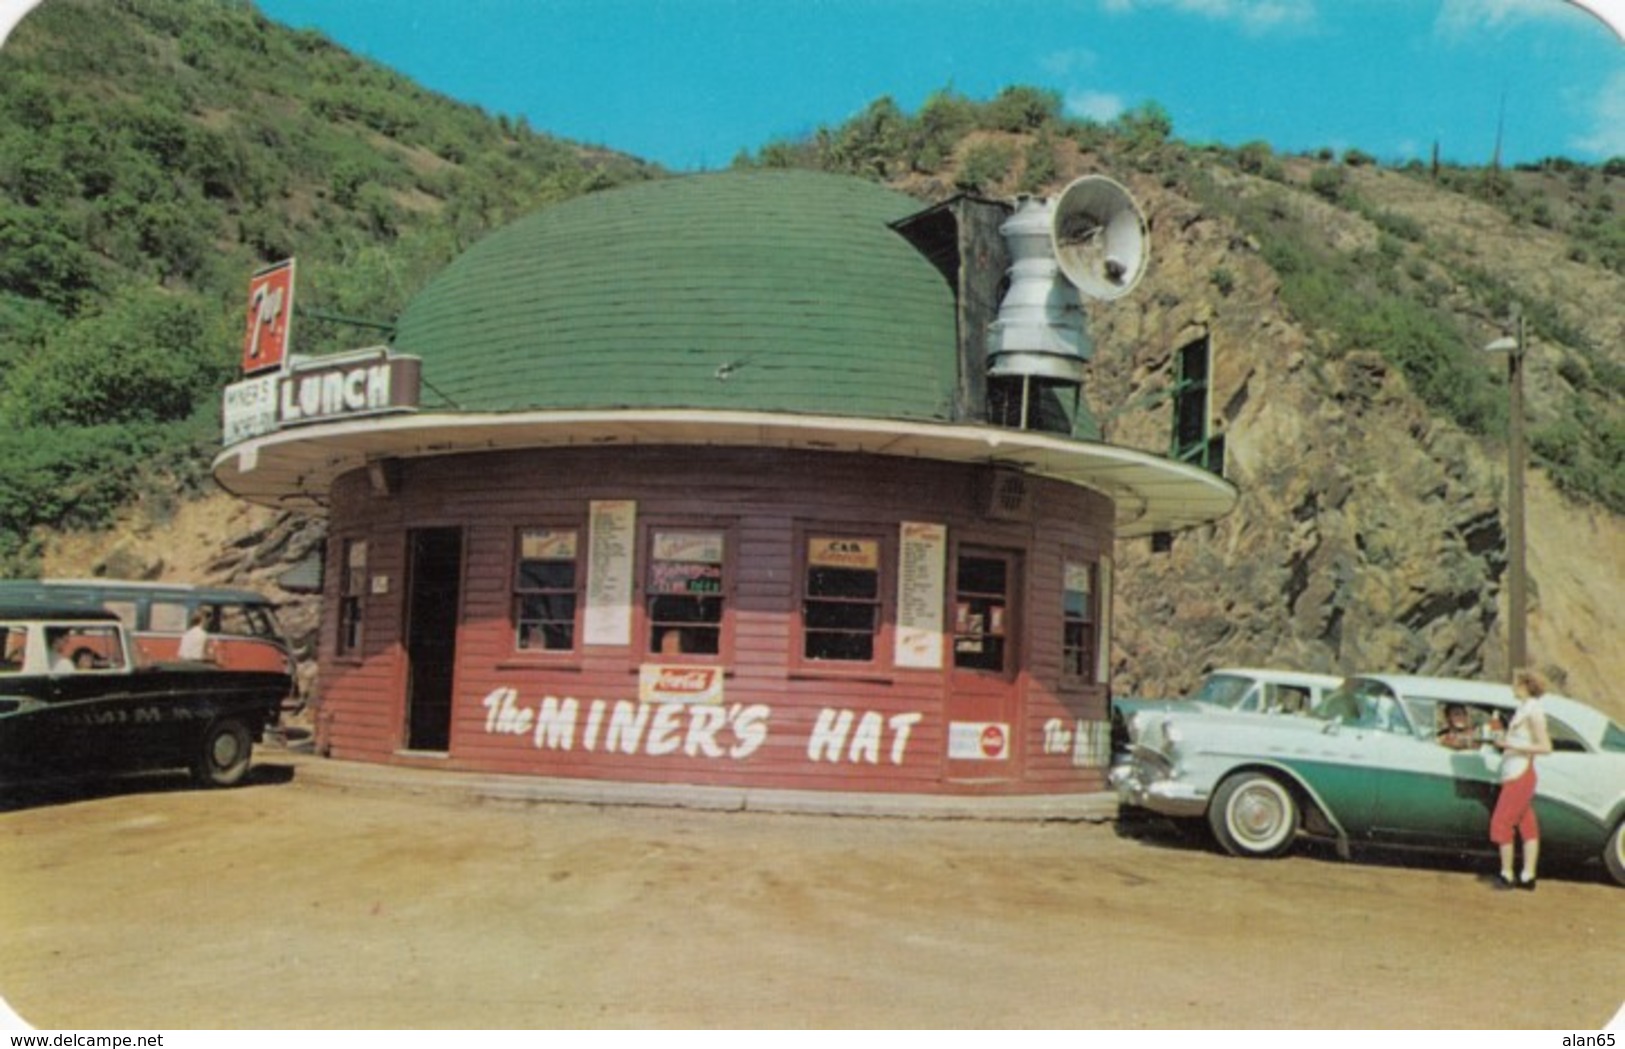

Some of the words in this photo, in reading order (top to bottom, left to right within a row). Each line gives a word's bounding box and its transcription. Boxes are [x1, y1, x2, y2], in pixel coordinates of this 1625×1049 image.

[282, 364, 391, 420] LUNCH
[483, 686, 533, 736] The
[533, 696, 772, 761] MINER'S
[807, 707, 923, 766] HAT
[1043, 717, 1073, 756] The
